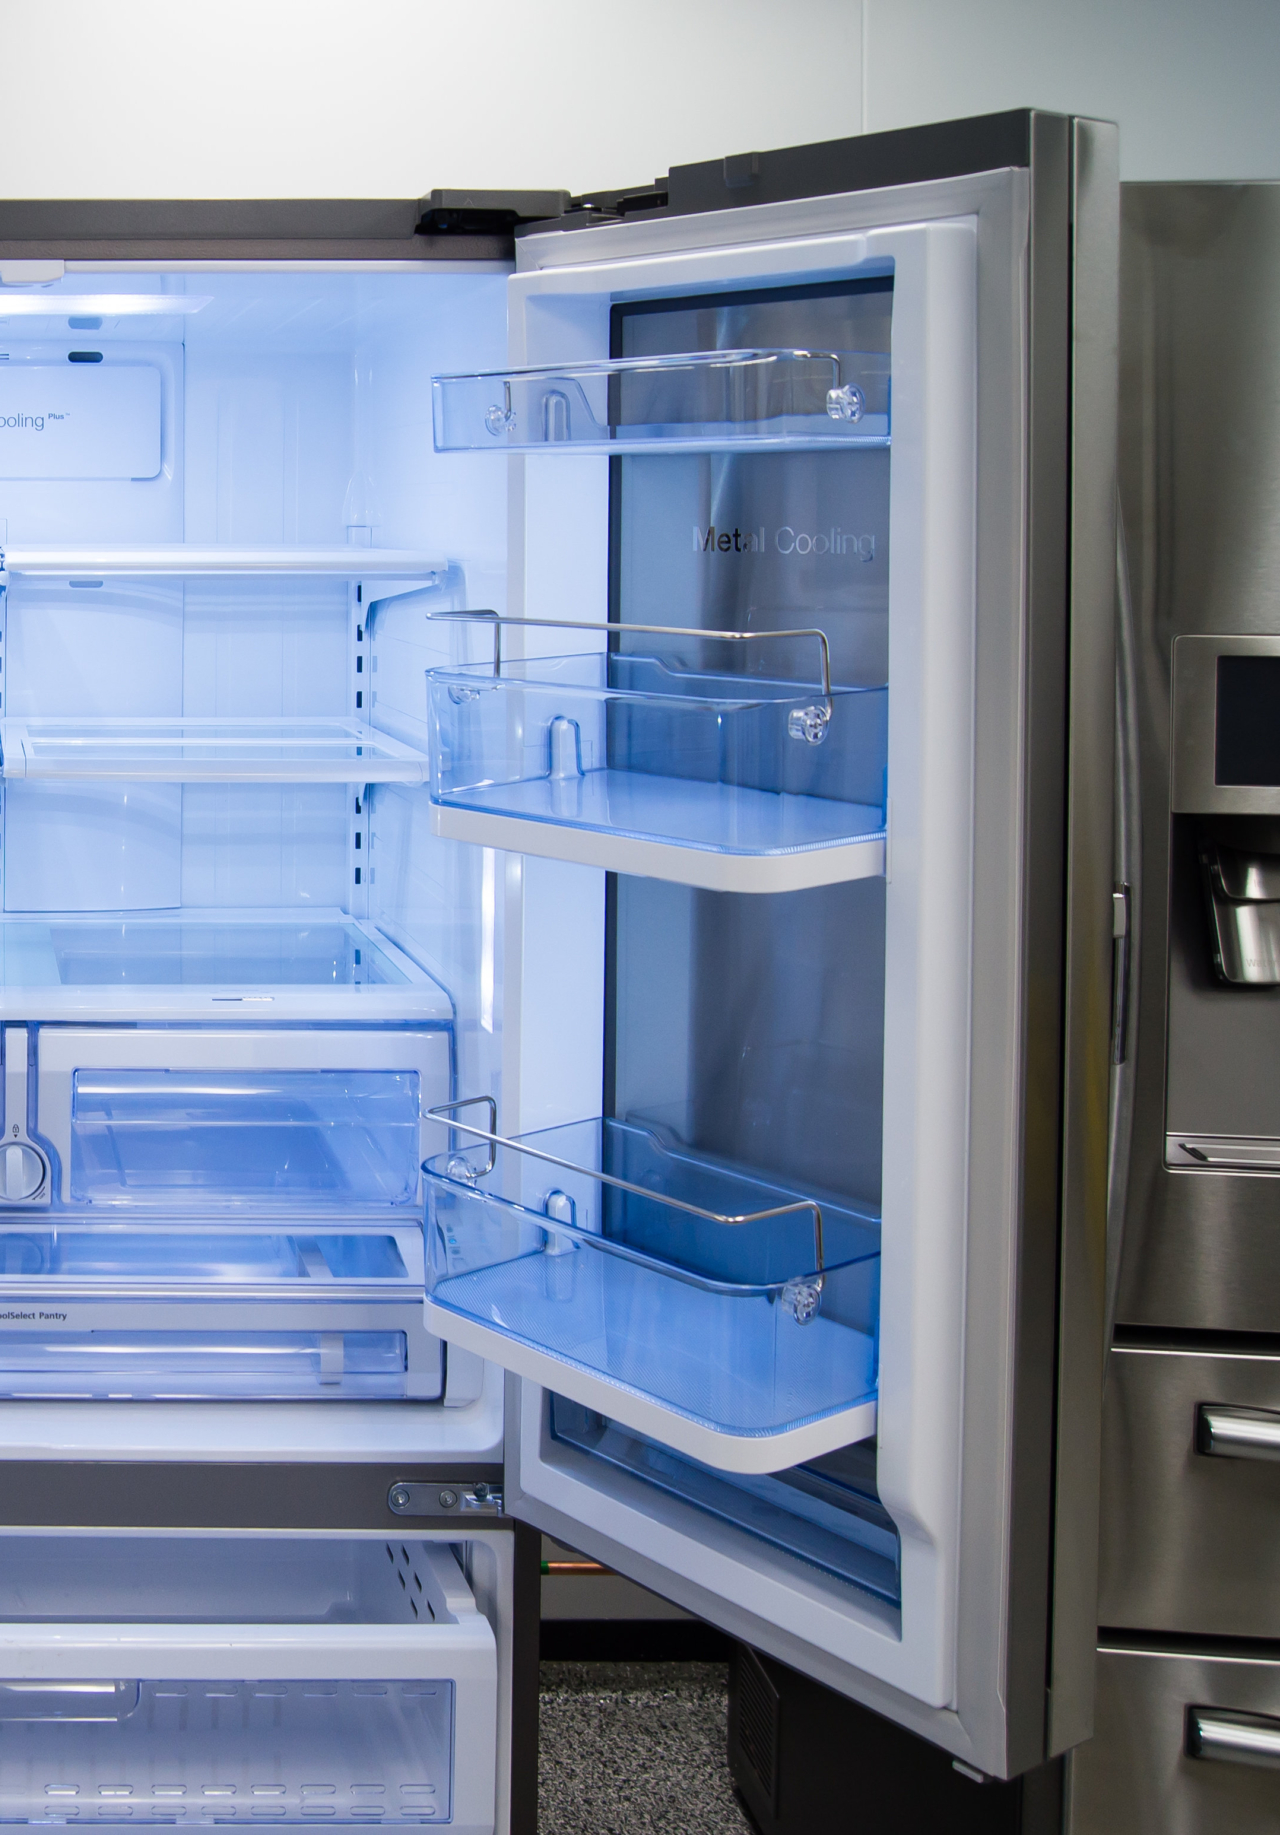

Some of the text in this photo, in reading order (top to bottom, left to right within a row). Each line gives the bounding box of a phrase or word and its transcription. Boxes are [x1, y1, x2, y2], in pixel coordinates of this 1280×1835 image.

[692, 526, 876, 563] Metal Cooling
[38, 1311, 67, 1321] Pantry
